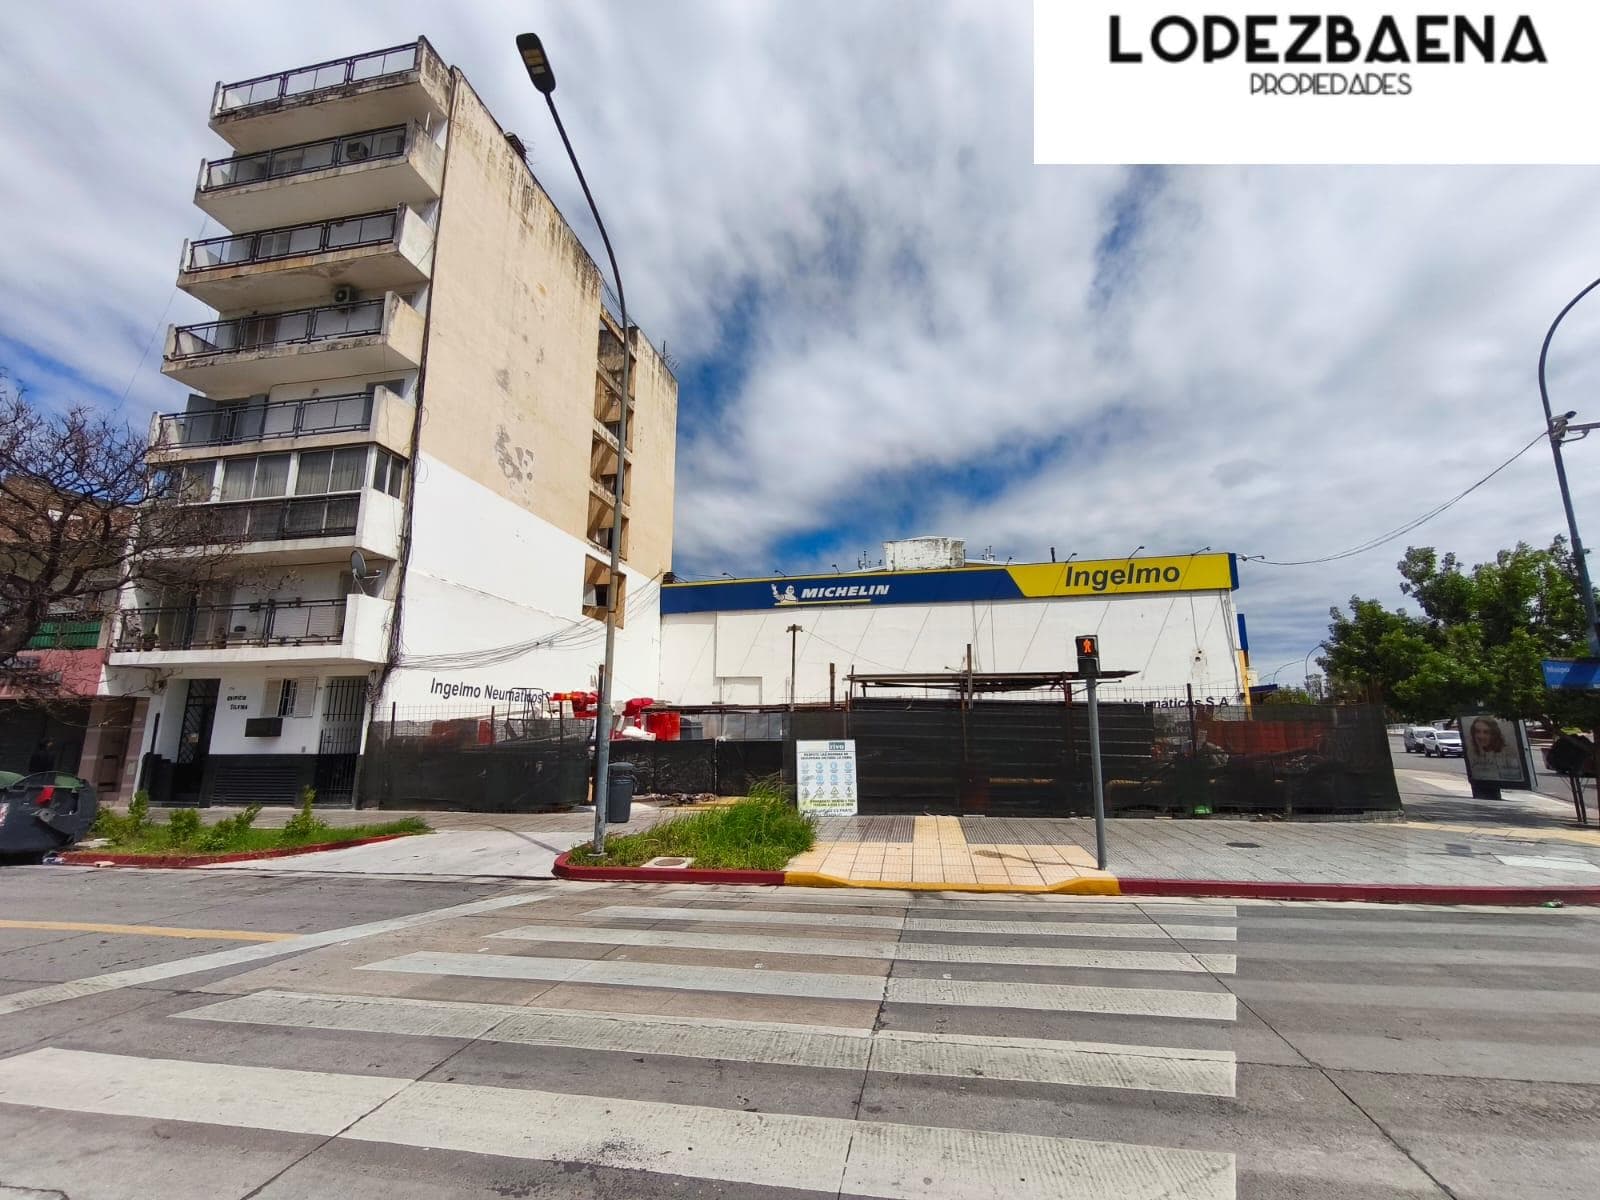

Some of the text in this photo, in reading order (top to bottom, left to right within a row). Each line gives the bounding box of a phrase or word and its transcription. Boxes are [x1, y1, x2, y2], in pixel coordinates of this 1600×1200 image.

[1066, 563, 1180, 591] Ingelmo
[801, 585, 890, 598] MICHELIN
[430, 678, 481, 700] Ingelmo
